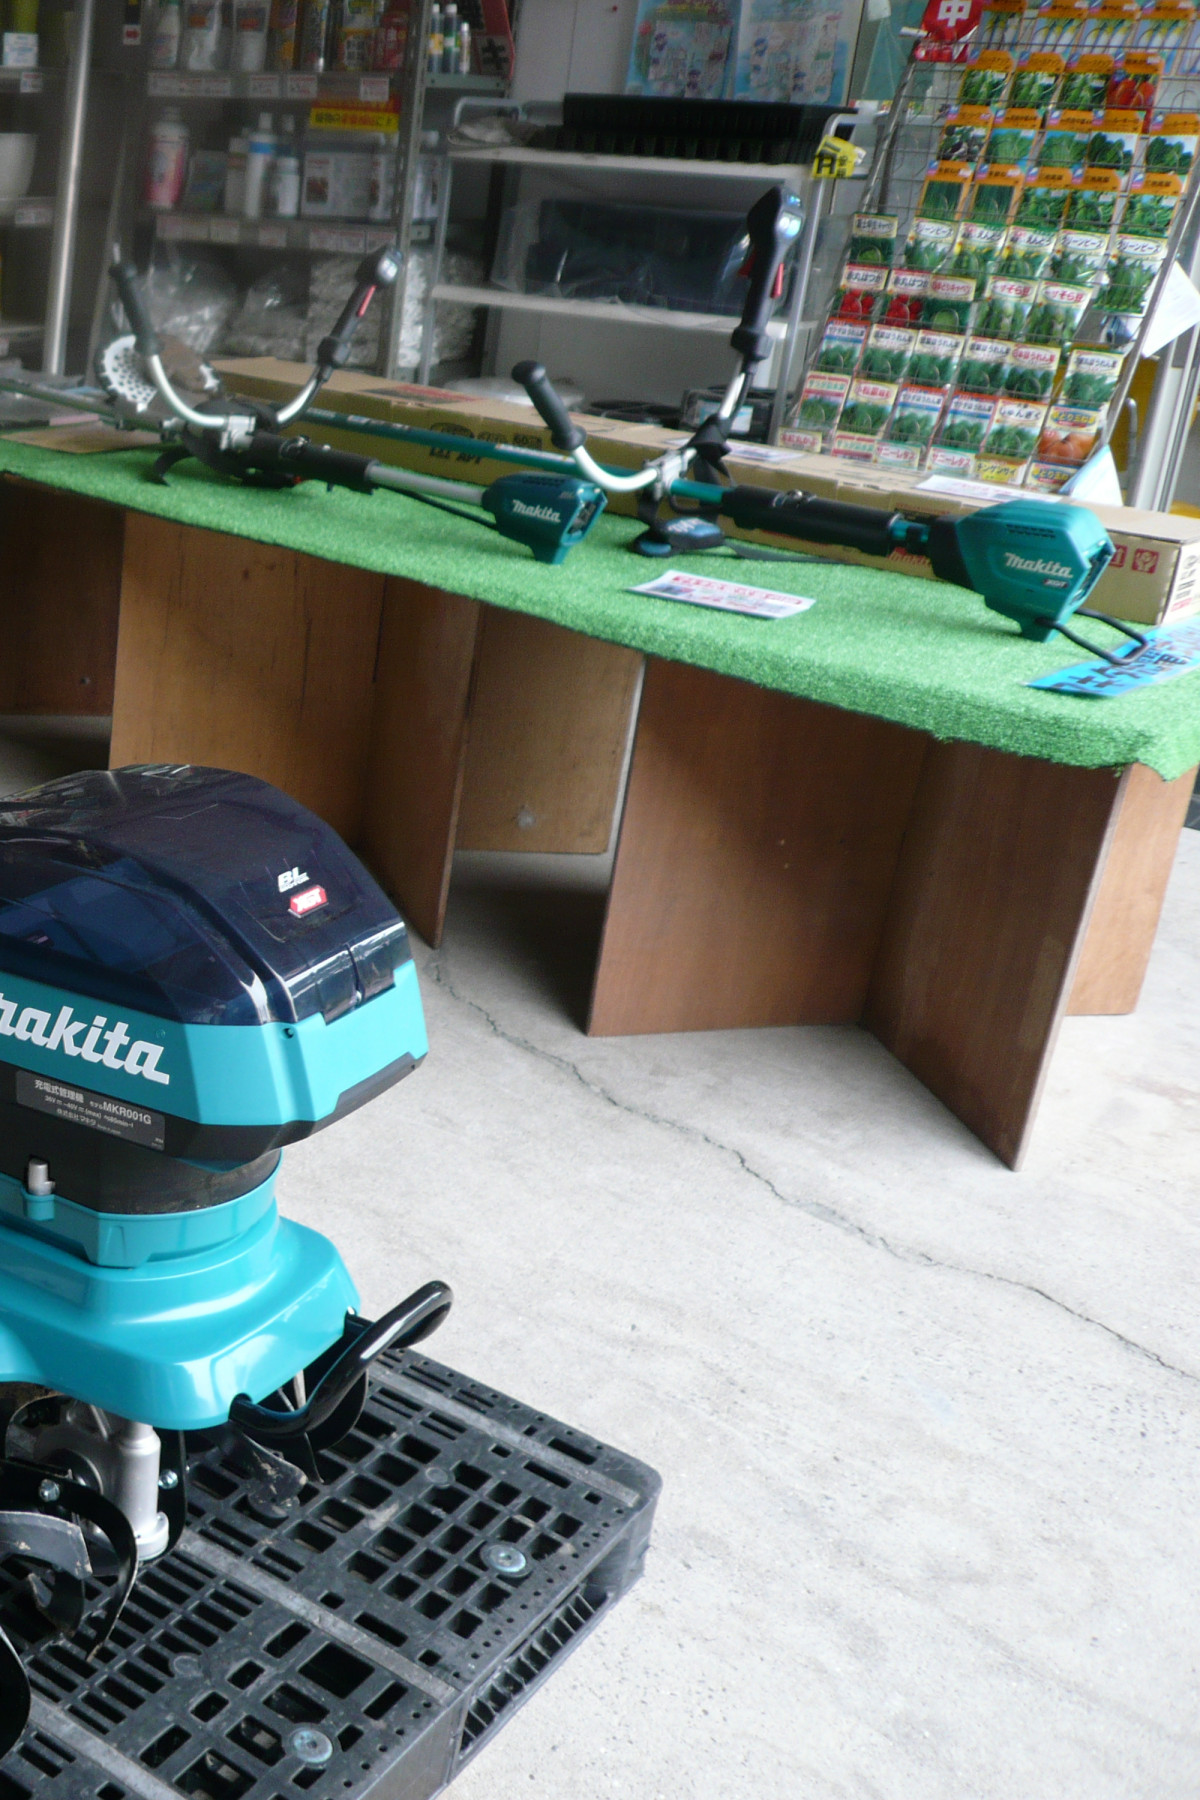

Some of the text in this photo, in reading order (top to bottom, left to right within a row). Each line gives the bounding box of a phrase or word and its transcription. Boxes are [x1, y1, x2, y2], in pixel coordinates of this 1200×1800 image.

[877, 447, 916, 461] サニーレタス
[932, 450, 970, 465] サニーレタス
[976, 462, 1016, 476] チンゲンサイ
[277, 867, 307, 888] BL
[33, 1079, 85, 1104] 充電式管理機
[103, 1101, 152, 1126] MKR001G
